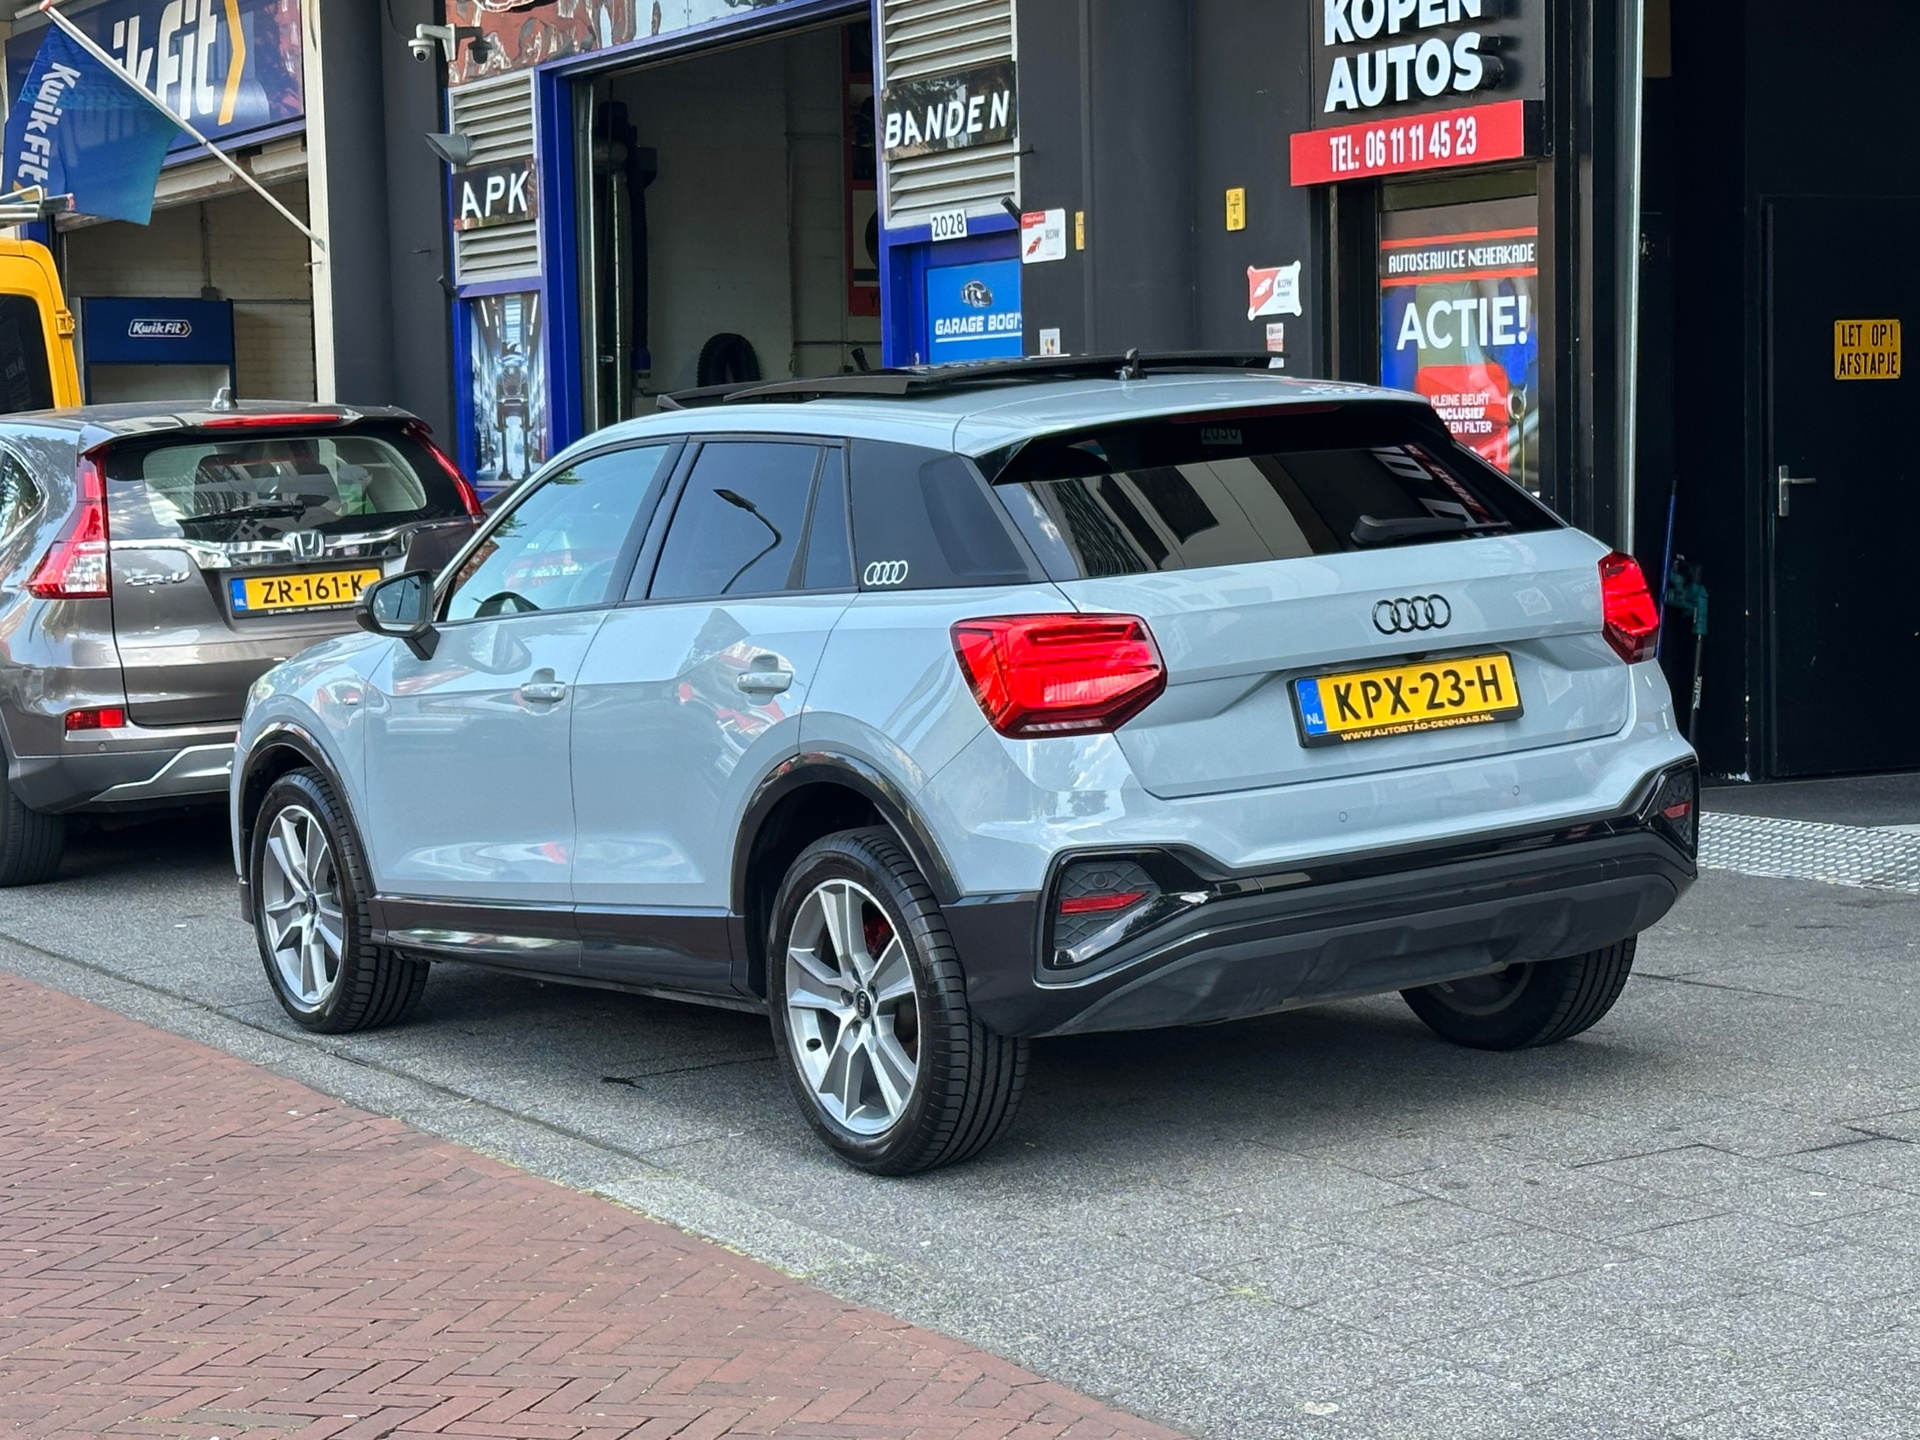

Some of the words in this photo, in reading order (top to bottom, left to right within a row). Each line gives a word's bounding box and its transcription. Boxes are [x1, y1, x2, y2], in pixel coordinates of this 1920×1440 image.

[1324, 32, 1484, 113] AUTOS
[884, 90, 1010, 149] BANDEN
[1330, 134, 1360, 173] TEL:
[1365, 130, 1386, 169] 06
[1390, 126, 1405, 164] 11
[1409, 124, 1425, 161] 11
[1429, 120, 1451, 159] 45
[1456, 116, 1477, 156] 23
[461, 170, 530, 221] APK
[932, 213, 964, 238] 2028
[1388, 249, 1466, 273] AUTOSERVICE
[1468, 243, 1535, 267] NEHERKADE
[935, 316, 985, 335] GARAGE
[1396, 295, 1528, 350] ACTIE!
[1841, 324, 1863, 347] LET
[1871, 323, 1894, 347] OP!
[1839, 351, 1898, 375] AFSTAPJE
[1430, 394, 1460, 407] KLEINE
[1461, 393, 1490, 405] BEURT
[1450, 421, 1463, 434] EN
[1464, 421, 1493, 433] FILTER
[234, 597, 246, 607] NL
[261, 574, 363, 605] ZR-161-K
[1307, 713, 1323, 725] NL
[1333, 663, 1503, 723] KPX-23-H
